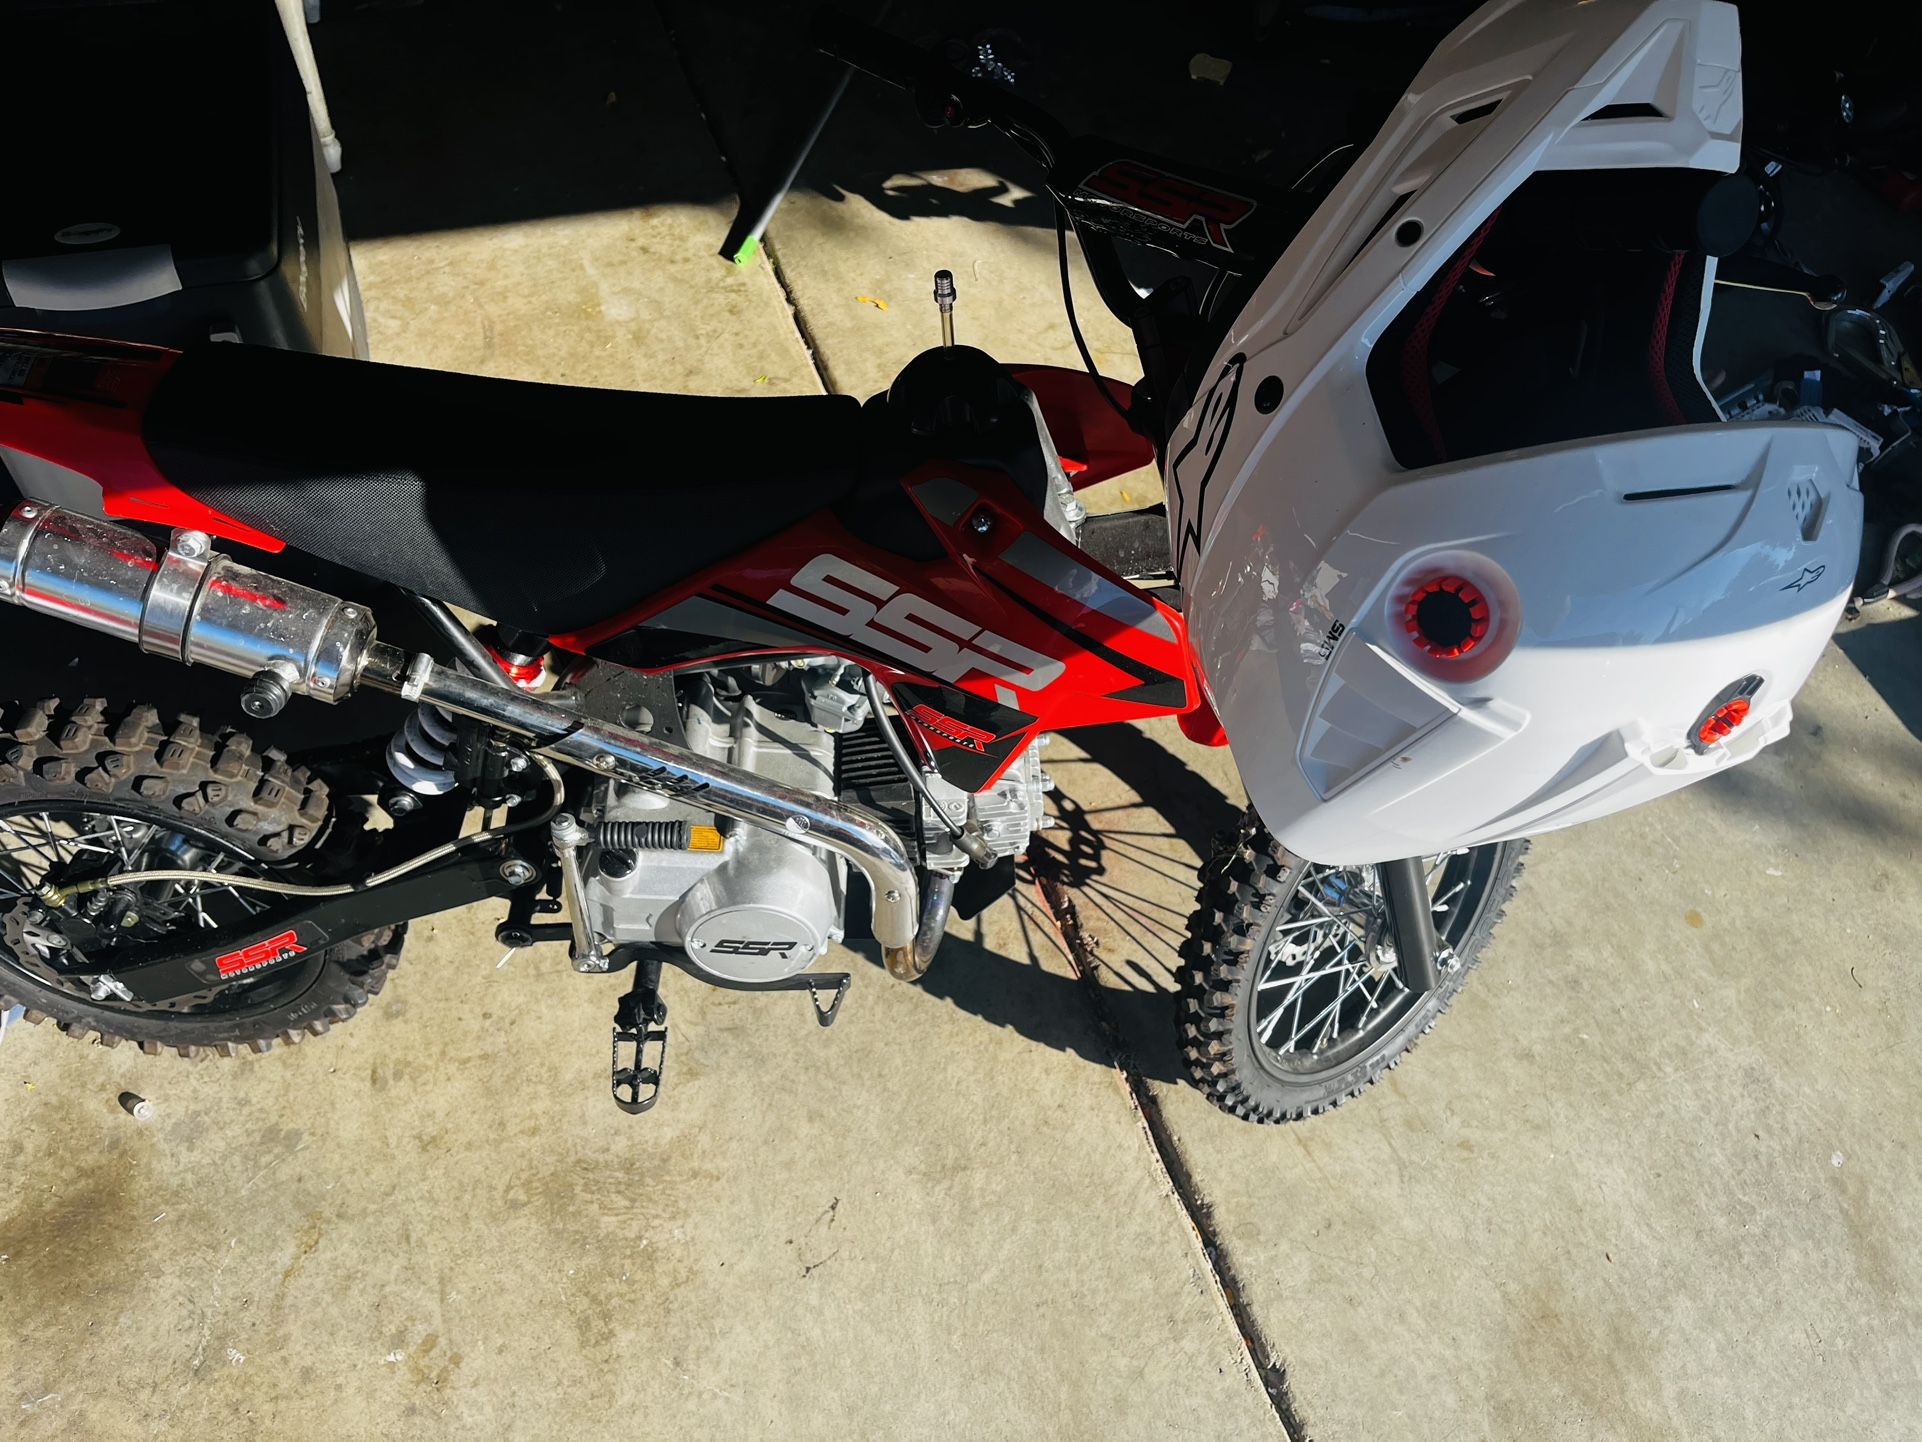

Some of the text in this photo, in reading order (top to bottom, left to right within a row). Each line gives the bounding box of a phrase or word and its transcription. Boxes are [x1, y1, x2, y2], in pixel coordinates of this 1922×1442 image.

[1072, 188, 1210, 246] MORSPORTS
[1078, 158, 1258, 253] SSR
[766, 553, 1066, 711] SSR
[905, 703, 997, 752] SSR
[216, 929, 308, 975] SSR
[709, 938, 798, 960] SSR
